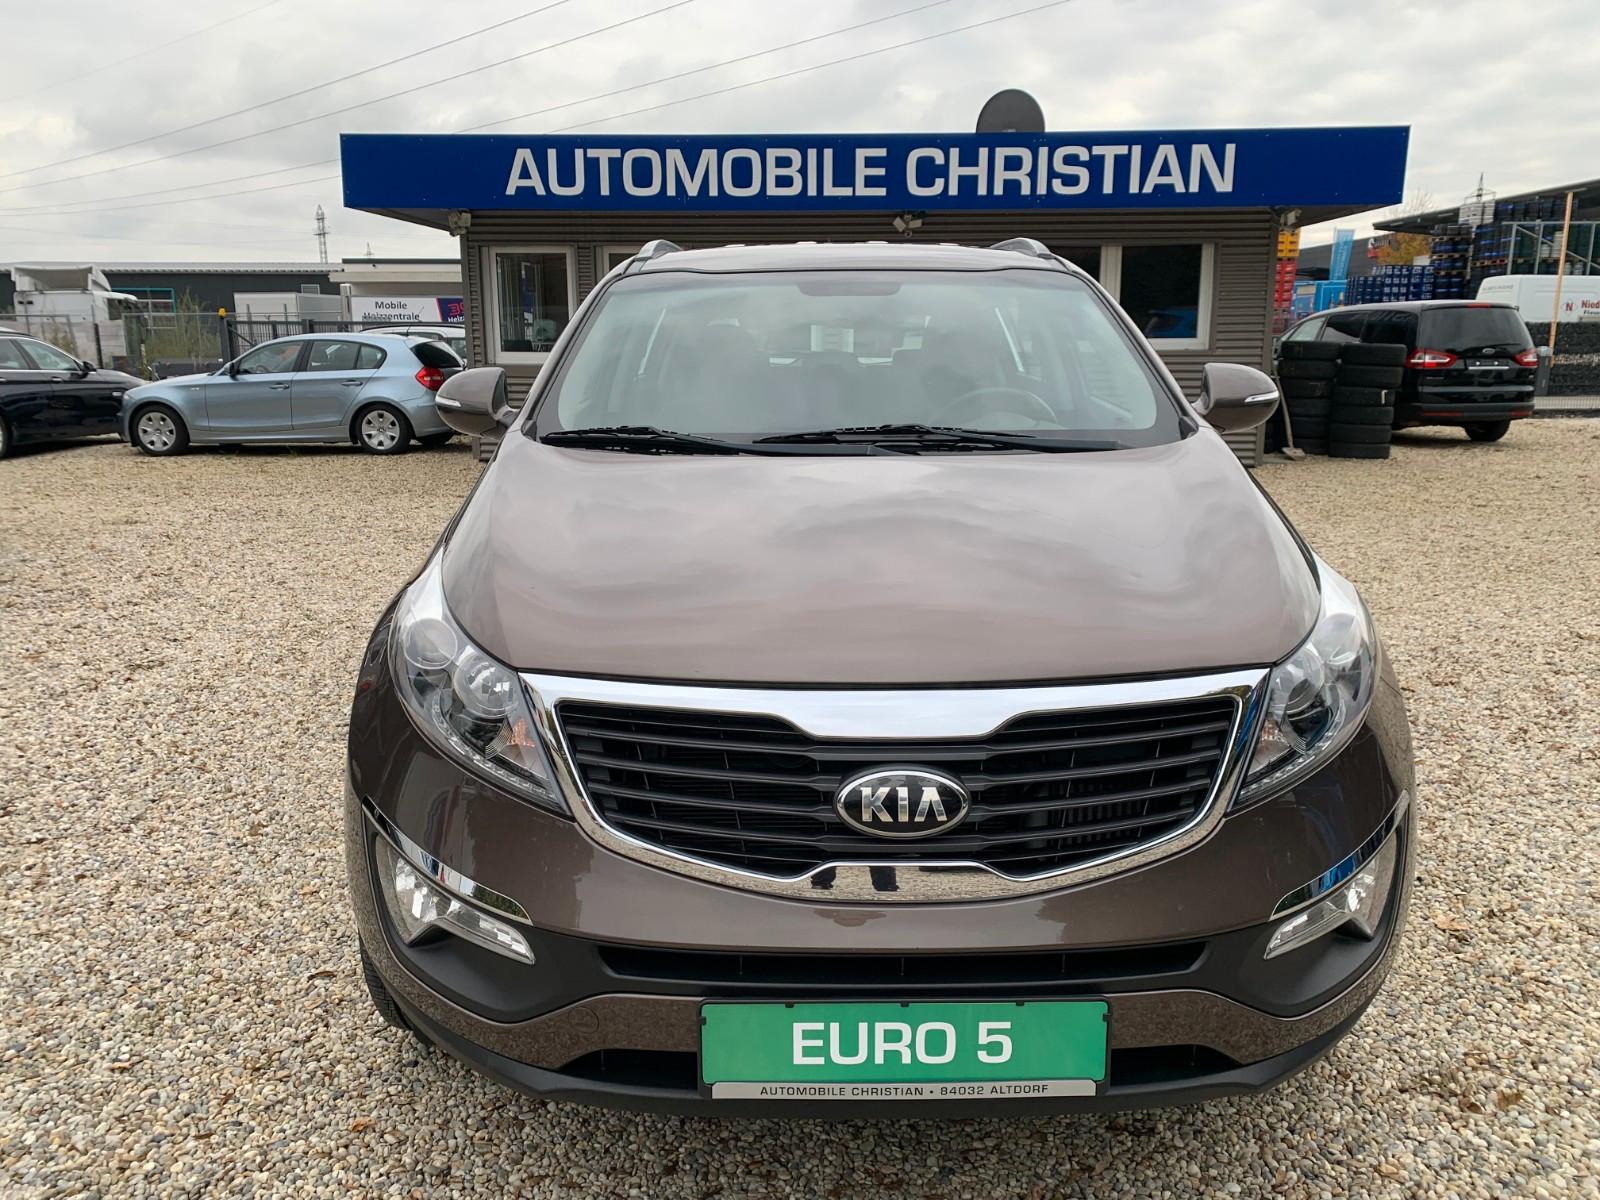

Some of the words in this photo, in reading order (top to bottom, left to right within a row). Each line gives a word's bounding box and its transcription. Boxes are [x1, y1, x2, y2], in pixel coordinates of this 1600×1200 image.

[505, 147, 887, 197] AUTOMOBILE
[906, 143, 1236, 197] CHRISTIAN
[375, 301, 408, 310] Mobile
[860, 786, 948, 823] KIA
[792, 1021, 957, 1065] EURO
[977, 1021, 1013, 1064] 5
[759, 1086, 846, 1097] AUTOMOBILE
[851, 1086, 924, 1097] CHRISTIAN
[940, 1086, 985, 1096] 84032
[990, 1083, 1049, 1095] ALTDORF
